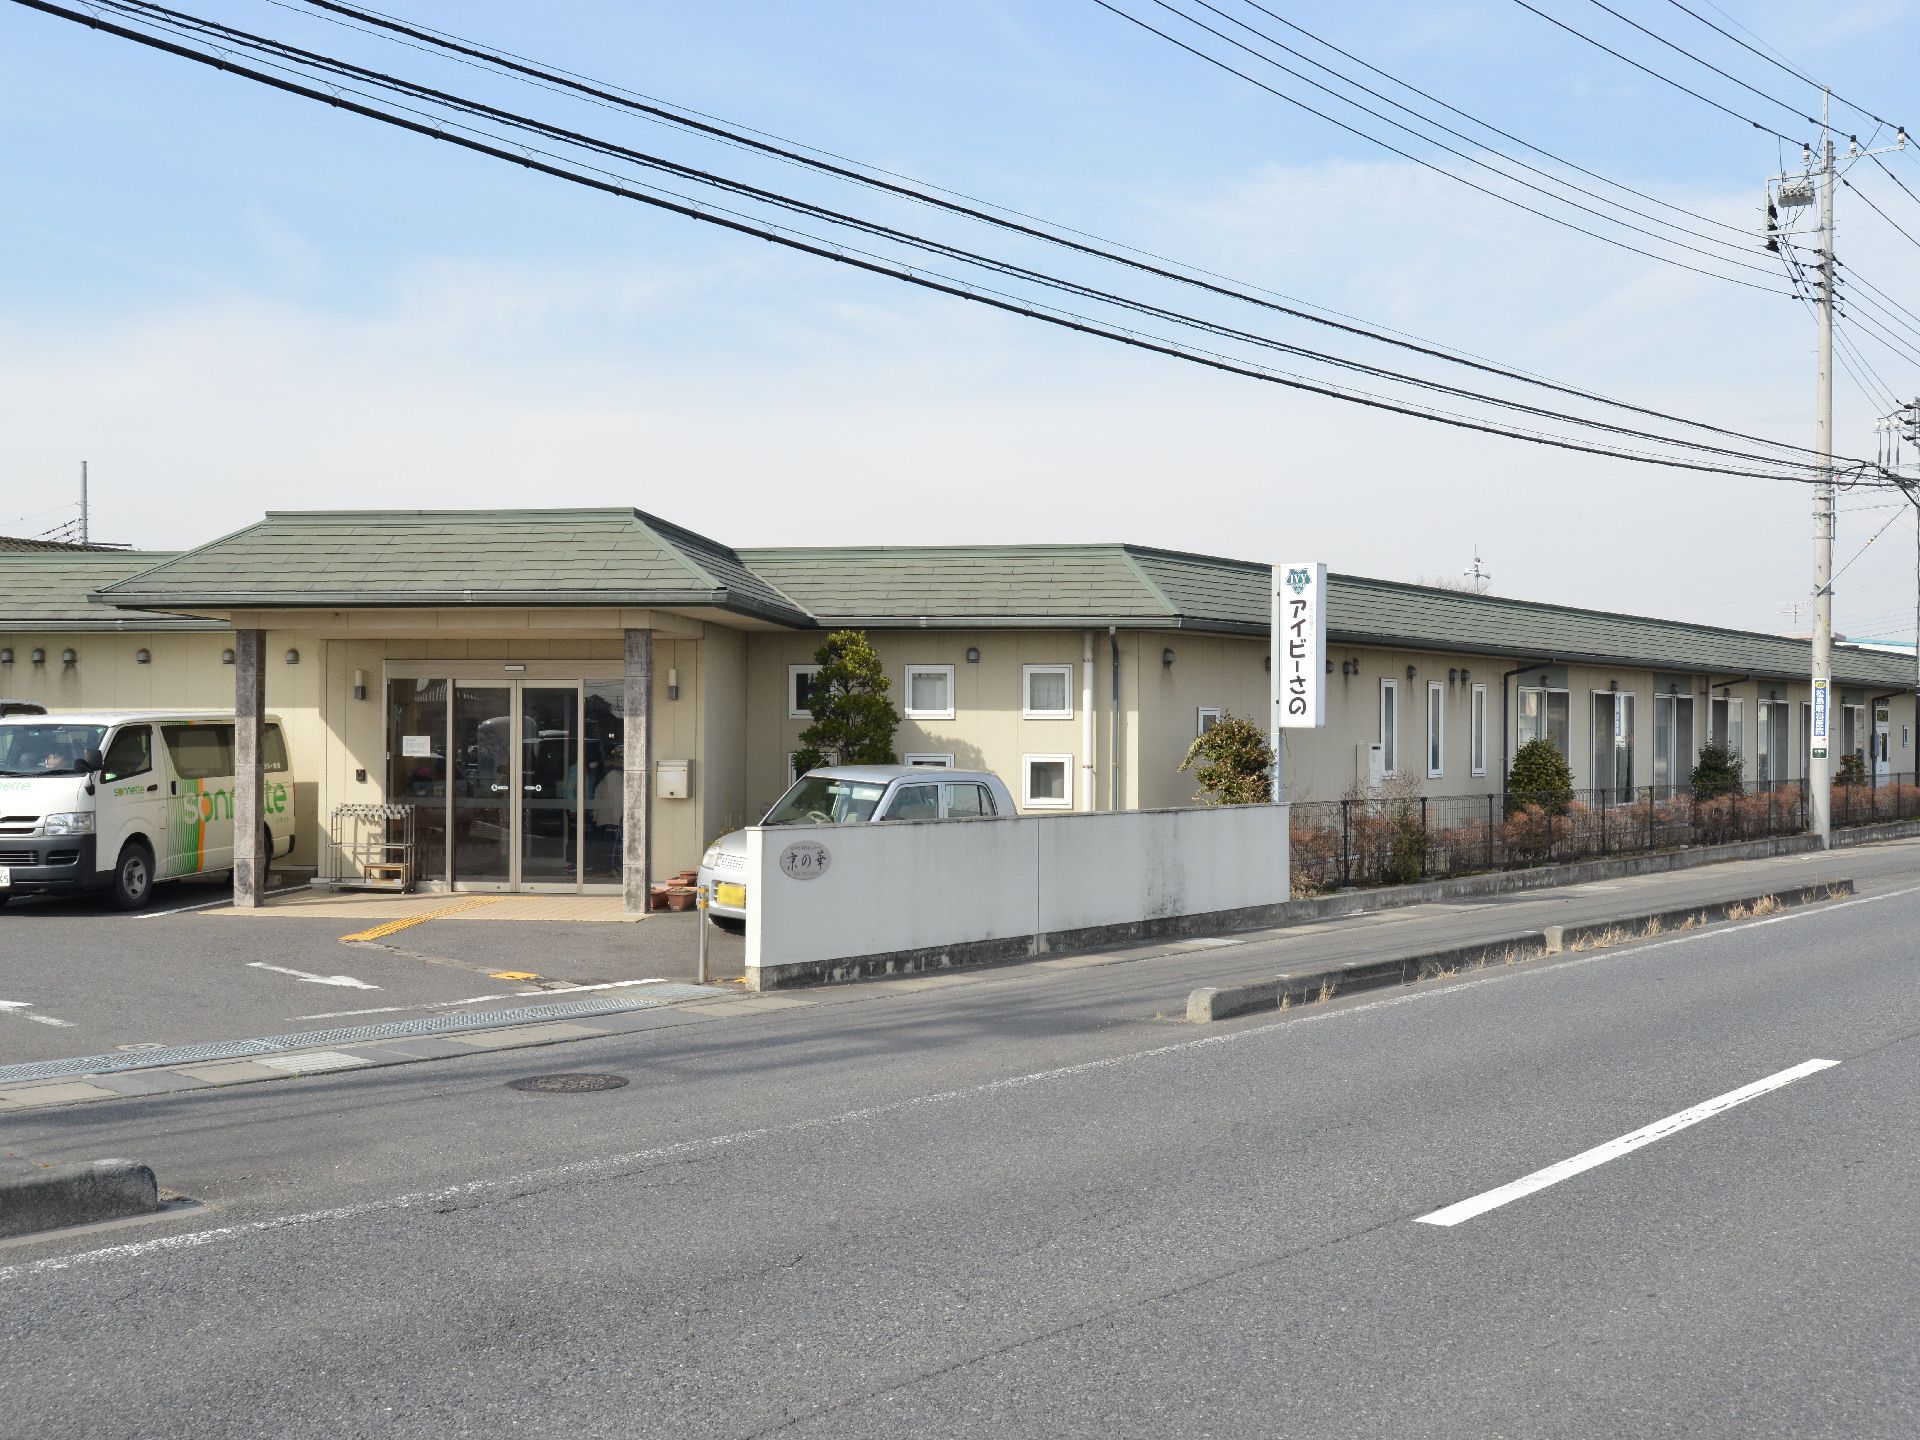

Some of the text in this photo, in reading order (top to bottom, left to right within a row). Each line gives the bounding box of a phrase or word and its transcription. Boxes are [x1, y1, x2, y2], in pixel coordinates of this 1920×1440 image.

[1290, 574, 1307, 584] IVY
[1289, 599, 1307, 715] アイビーさの
[113, 784, 145, 797] sonnette
